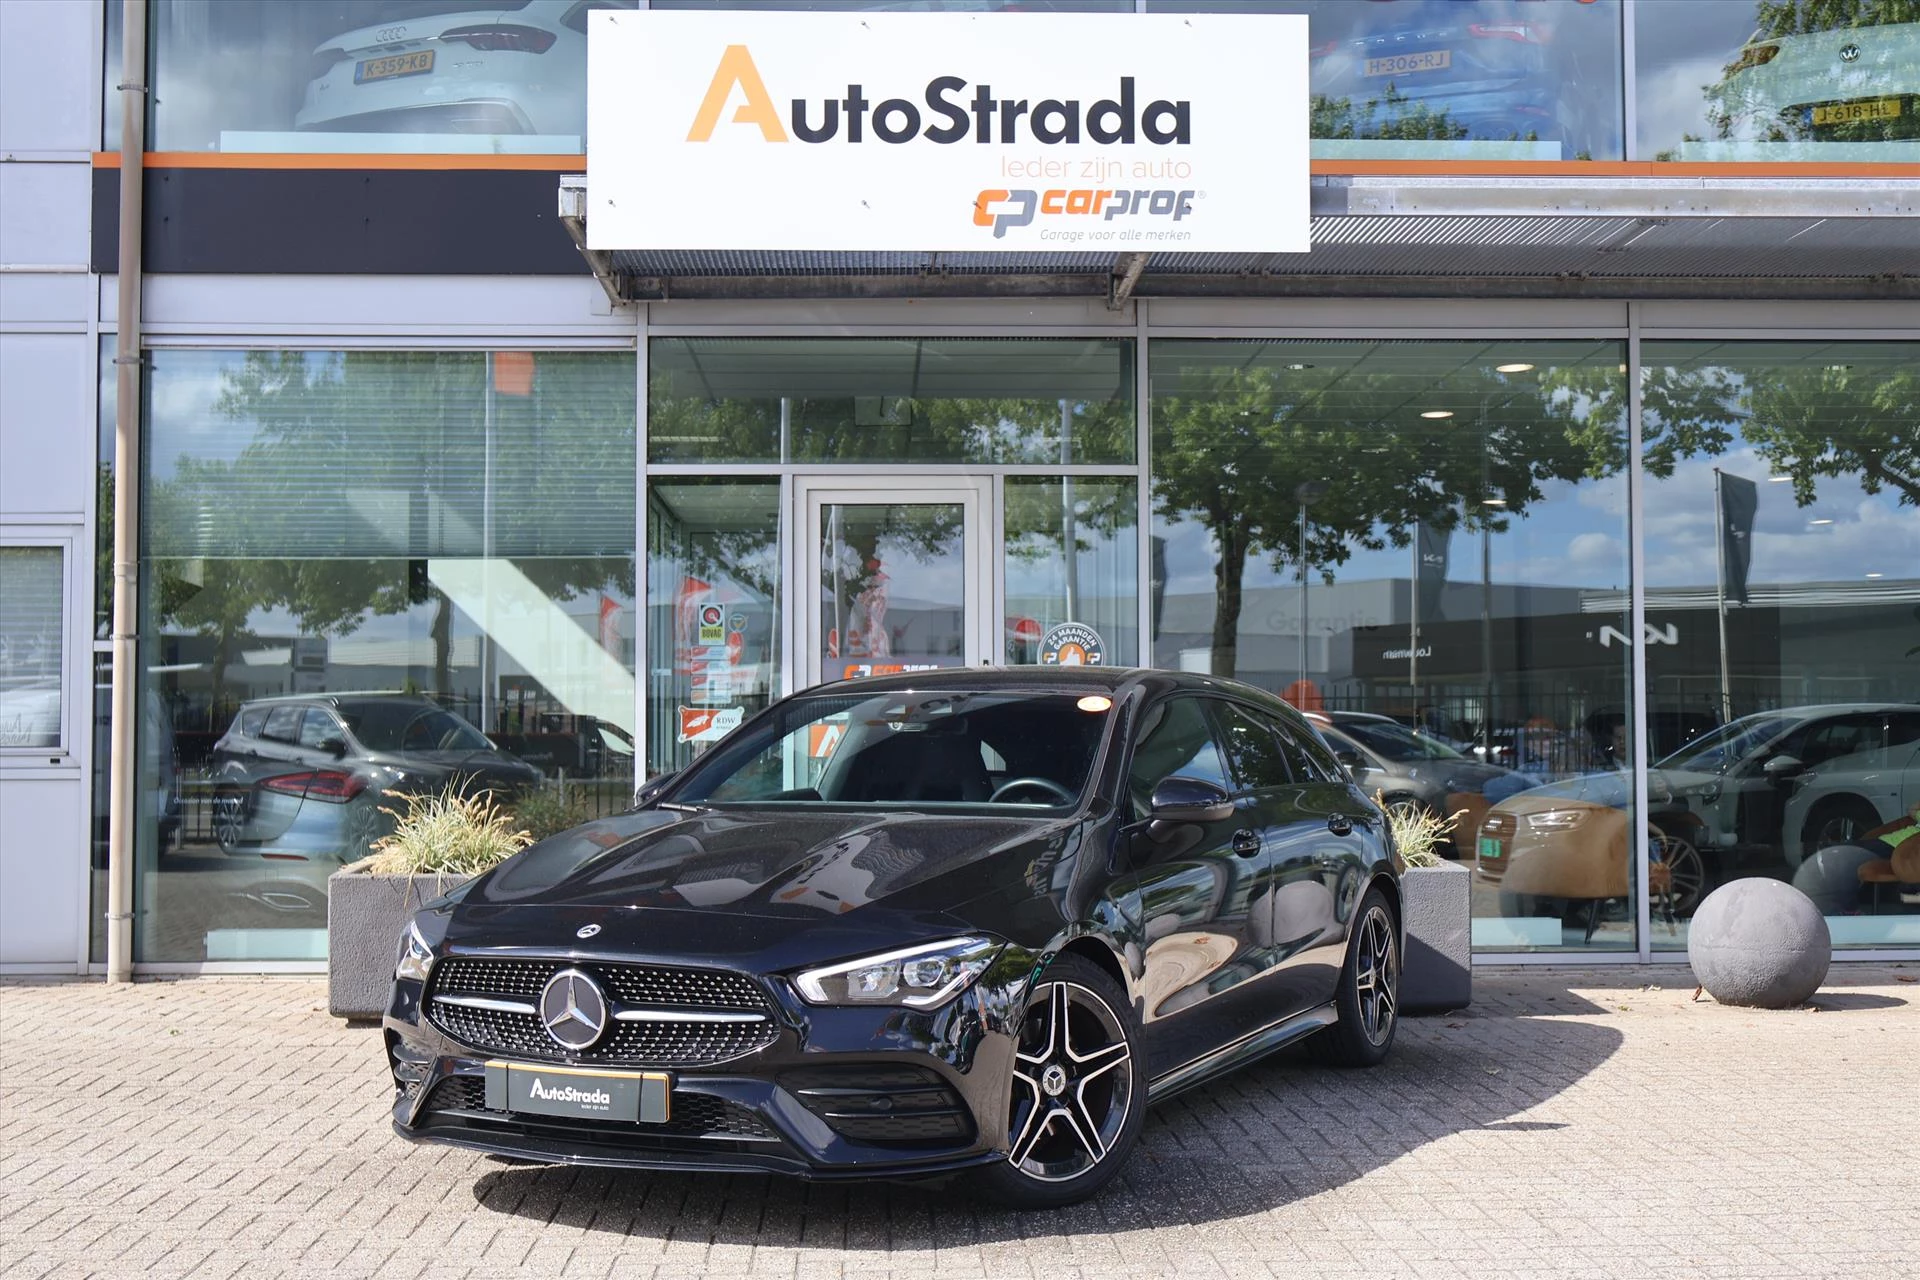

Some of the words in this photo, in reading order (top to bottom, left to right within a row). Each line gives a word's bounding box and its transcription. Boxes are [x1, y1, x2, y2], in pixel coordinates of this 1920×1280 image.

[365, 53, 428, 77] K-359-KB
[1369, 52, 1445, 74] H-306-RJ
[685, 44, 1192, 145] AutoStrada
[1001, 155, 1071, 179] Ieder
[1080, 157, 1123, 184] zijn
[1132, 158, 1192, 180] auto
[1041, 189, 1196, 222] carprof
[1040, 228, 1085, 243] Garage
[1089, 230, 1115, 240] voor
[1119, 229, 1142, 241] alle
[1145, 229, 1192, 241] merken
[1047, 635, 1058, 646] 24
[1057, 628, 1097, 647] MAANDEN
[1053, 635, 1091, 651] GARANTIE
[716, 716, 736, 724] RDW
[529, 1077, 611, 1104] AutoStrada
